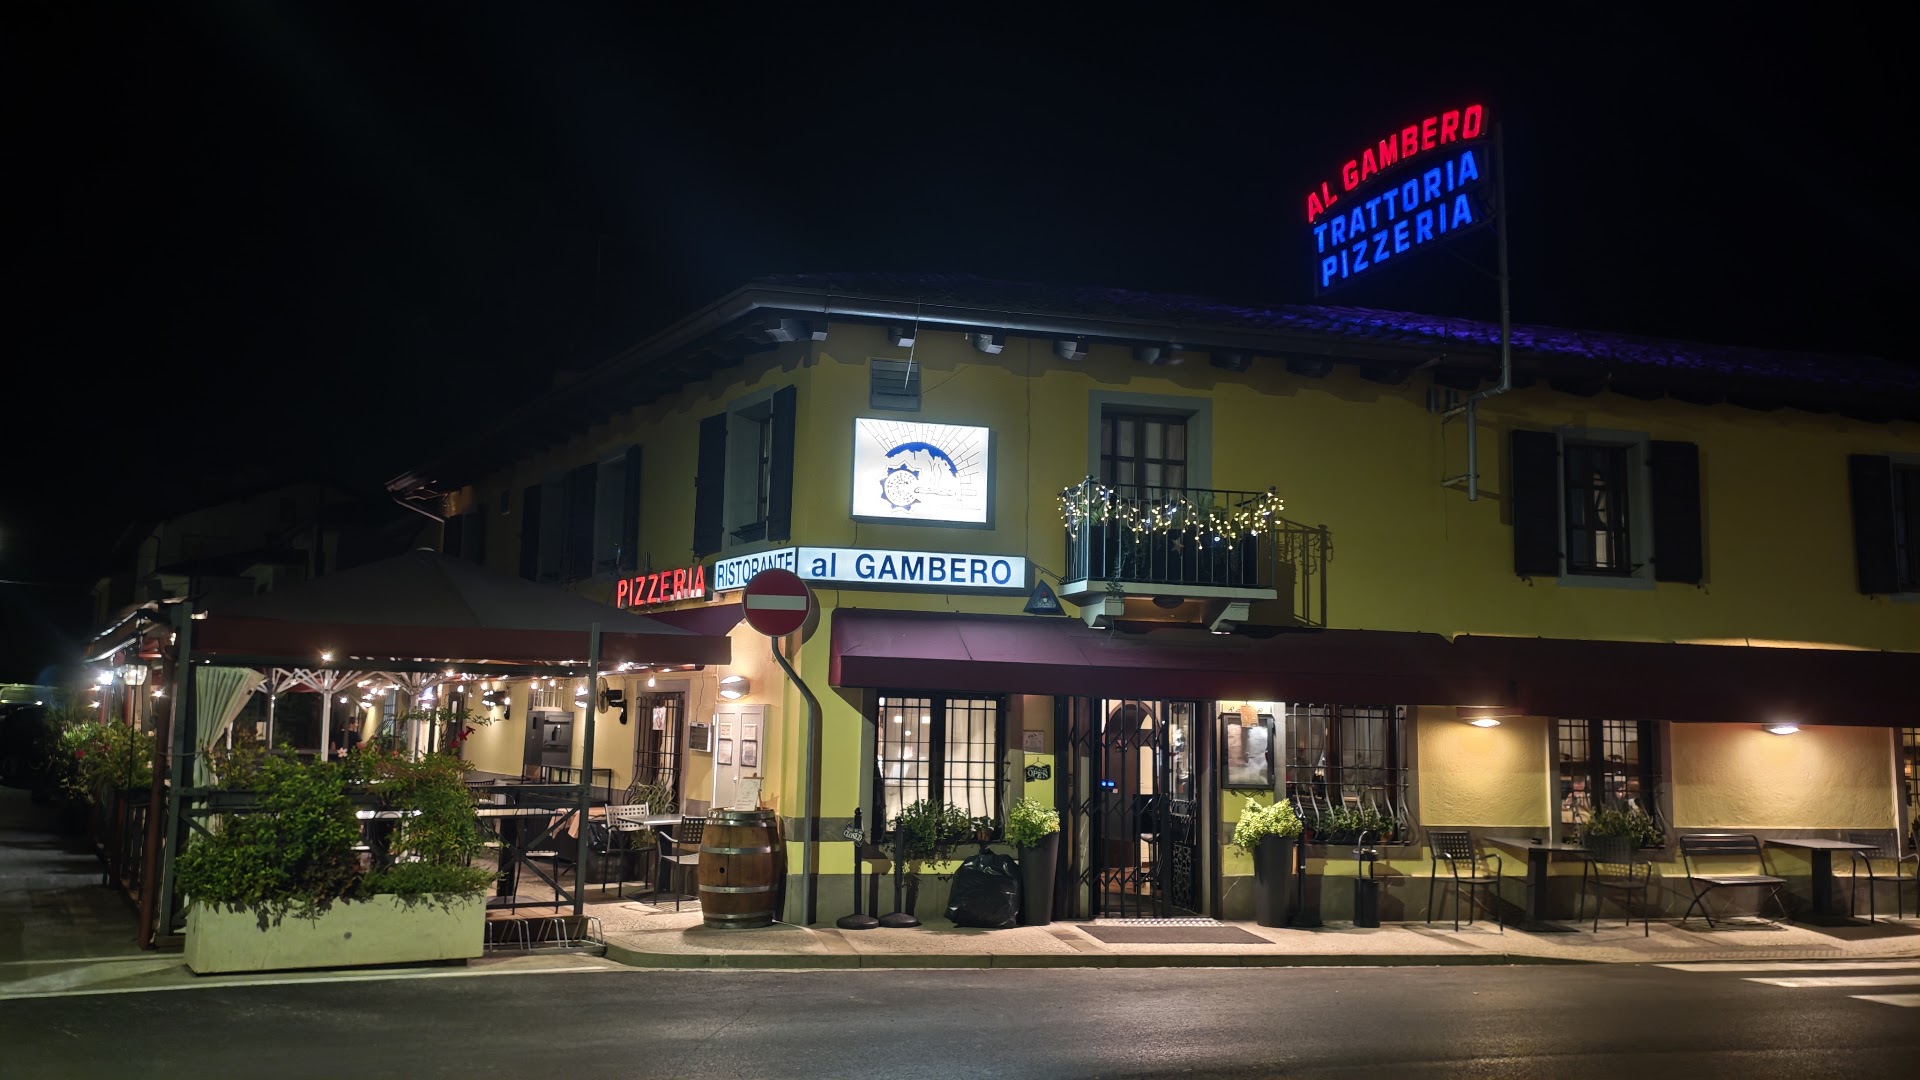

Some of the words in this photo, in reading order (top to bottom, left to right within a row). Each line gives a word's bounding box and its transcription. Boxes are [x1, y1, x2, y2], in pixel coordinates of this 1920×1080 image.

[1307, 182, 1337, 223] AL
[1342, 104, 1482, 191] GAMBERO
[1313, 150, 1478, 253] TRATTORIA
[1322, 194, 1472, 287] PIZZERIA
[616, 565, 705, 609] PIZZERIA
[811, 553, 836, 577] al
[855, 553, 1012, 585] GAMBERO
[1027, 769, 1048, 779] OPEN
